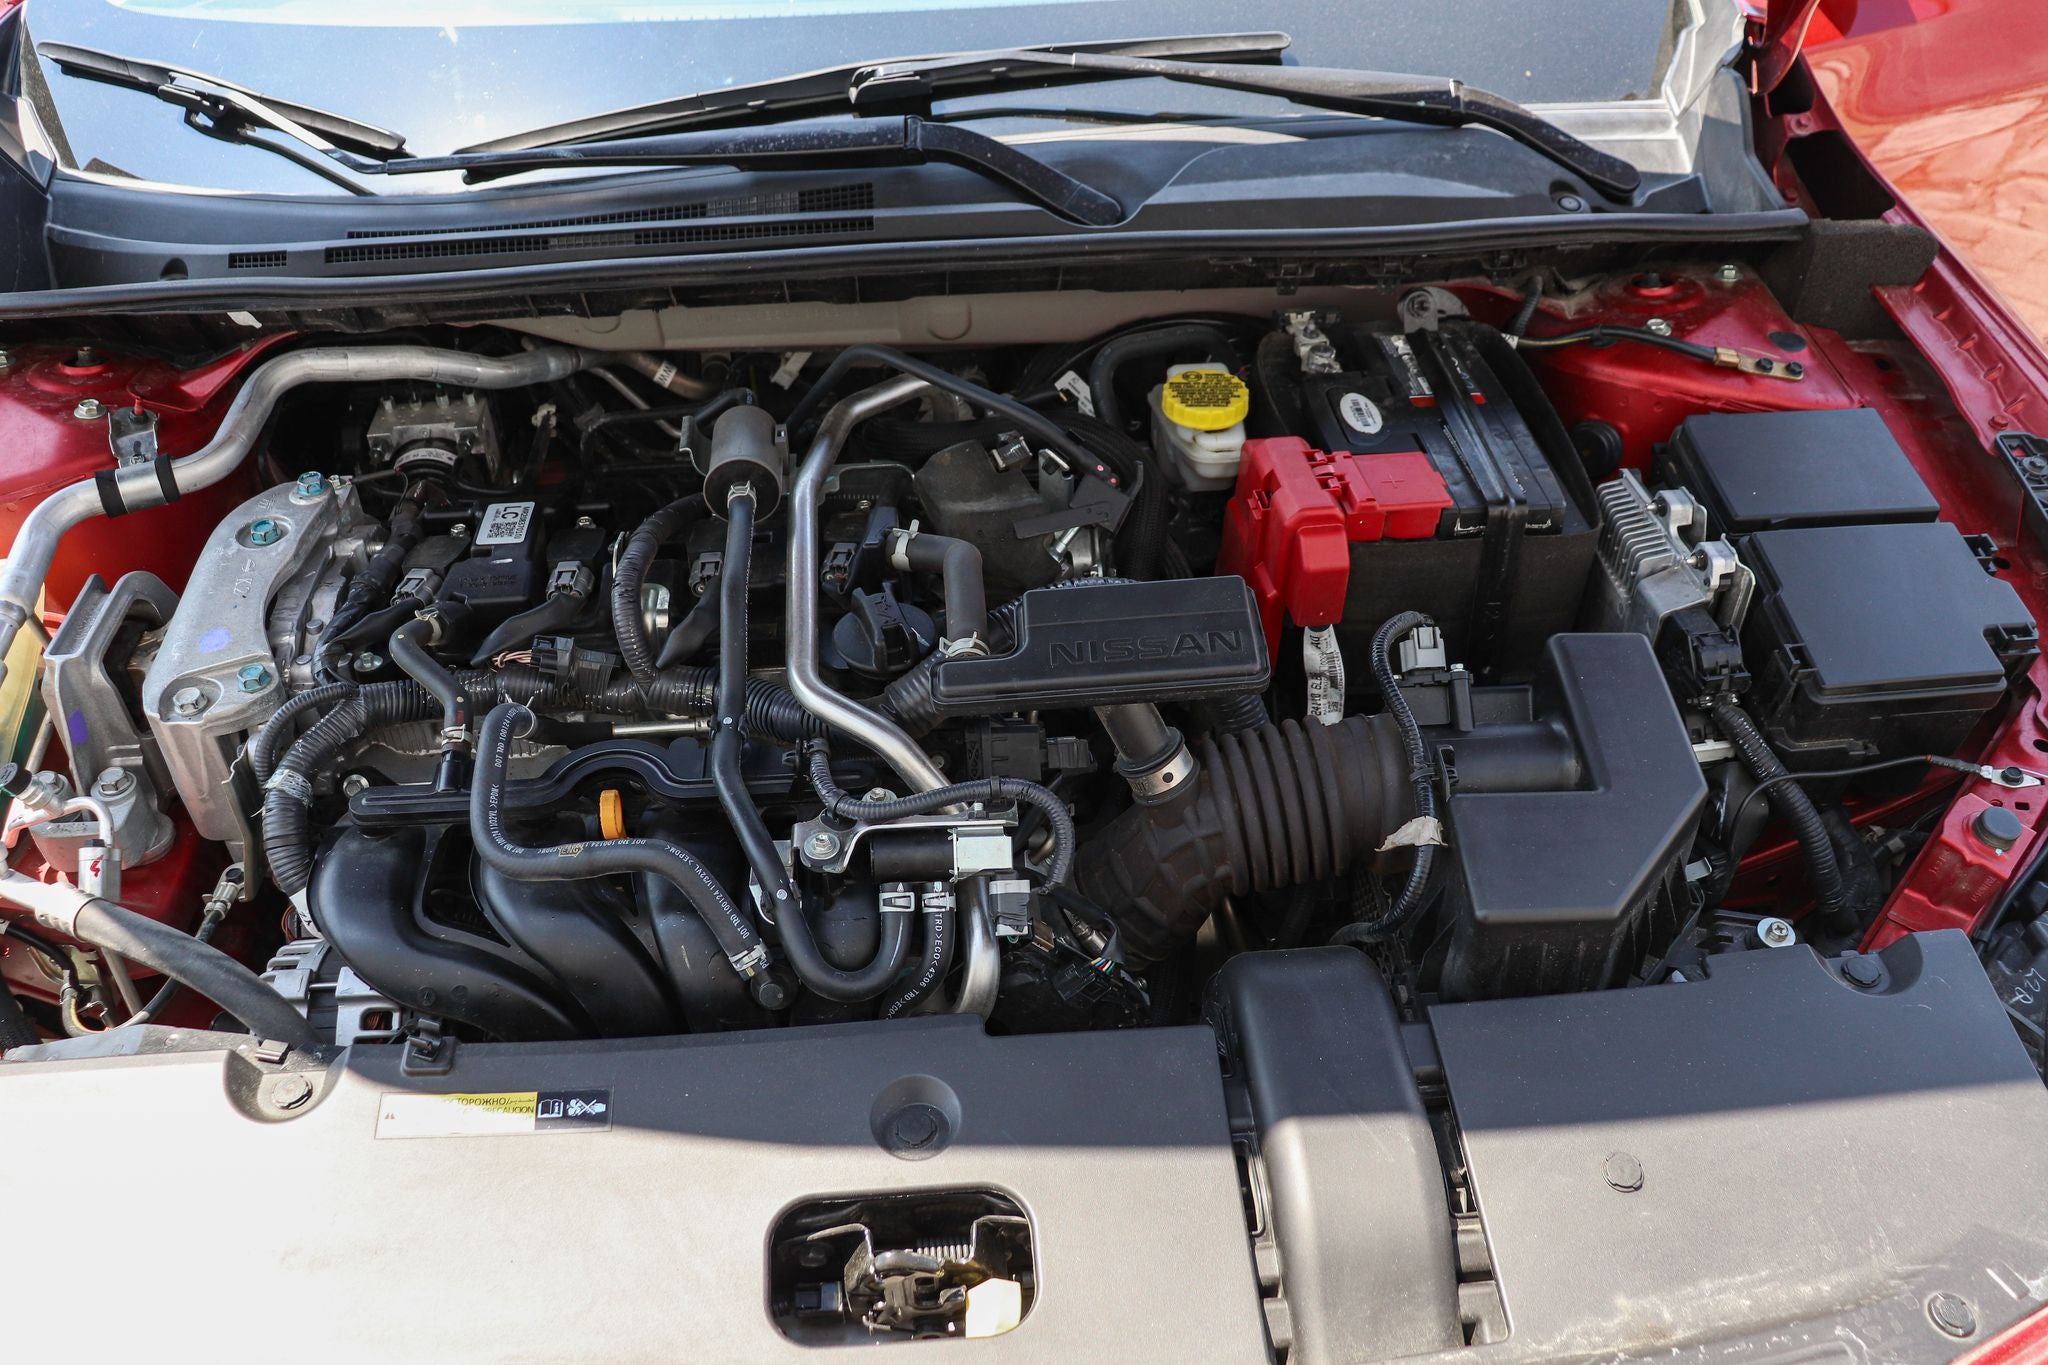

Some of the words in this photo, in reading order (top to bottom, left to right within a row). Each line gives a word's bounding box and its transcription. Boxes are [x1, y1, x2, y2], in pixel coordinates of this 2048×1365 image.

[501, 505, 522, 519] LC
[1049, 630, 1244, 666] NISSAN
[713, 890, 731, 915] 100124
